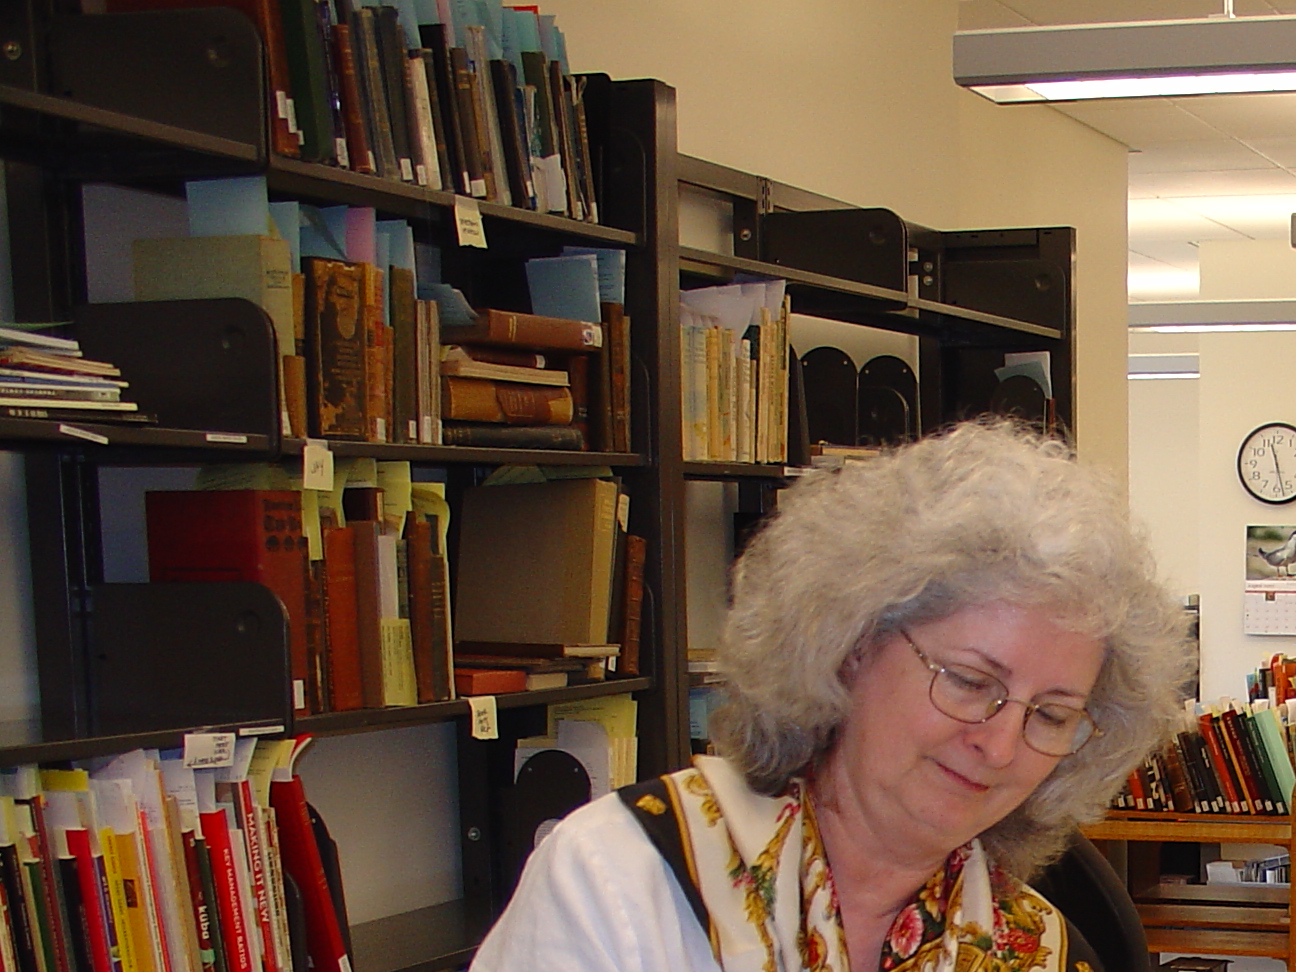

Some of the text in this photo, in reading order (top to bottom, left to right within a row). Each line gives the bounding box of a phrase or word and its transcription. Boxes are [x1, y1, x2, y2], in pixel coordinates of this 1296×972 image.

[1263, 439, 1270, 447] 11
[1273, 435, 1284, 444] 12
[1289, 439, 1293, 447] 1
[1253, 448, 1265, 456] 10
[1250, 460, 1257, 468] 9
[1253, 471, 1260, 480] 8
[1262, 480, 1268, 488] 7
[1285, 481, 1292, 489] 5
[1273, 484, 1280, 493] 6
[246, 812, 270, 923] MAKING IT NEW
[222, 848, 249, 970] KEY MANAGEMENT RATIOS
